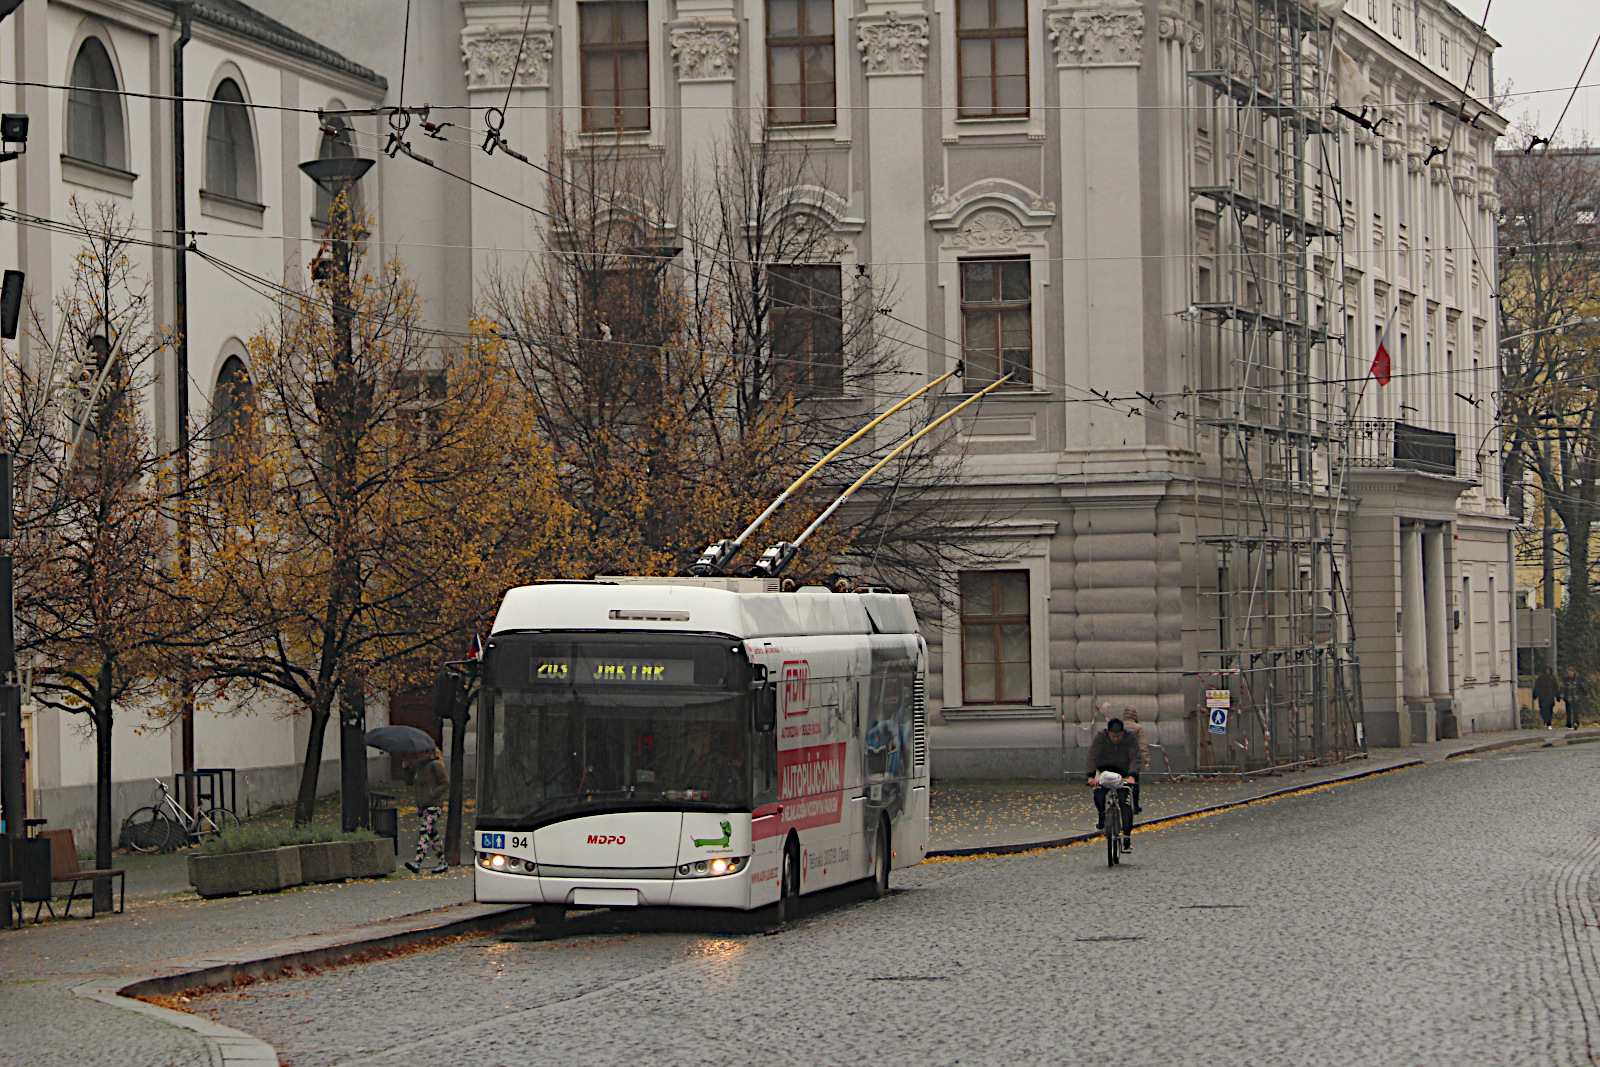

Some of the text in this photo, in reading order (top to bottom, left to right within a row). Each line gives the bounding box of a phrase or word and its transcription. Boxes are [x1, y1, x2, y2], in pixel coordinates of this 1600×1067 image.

[782, 751, 840, 799] AUTOPŮJČOVNA
[512, 836, 528, 849] 94
[586, 834, 627, 846] MDPO
